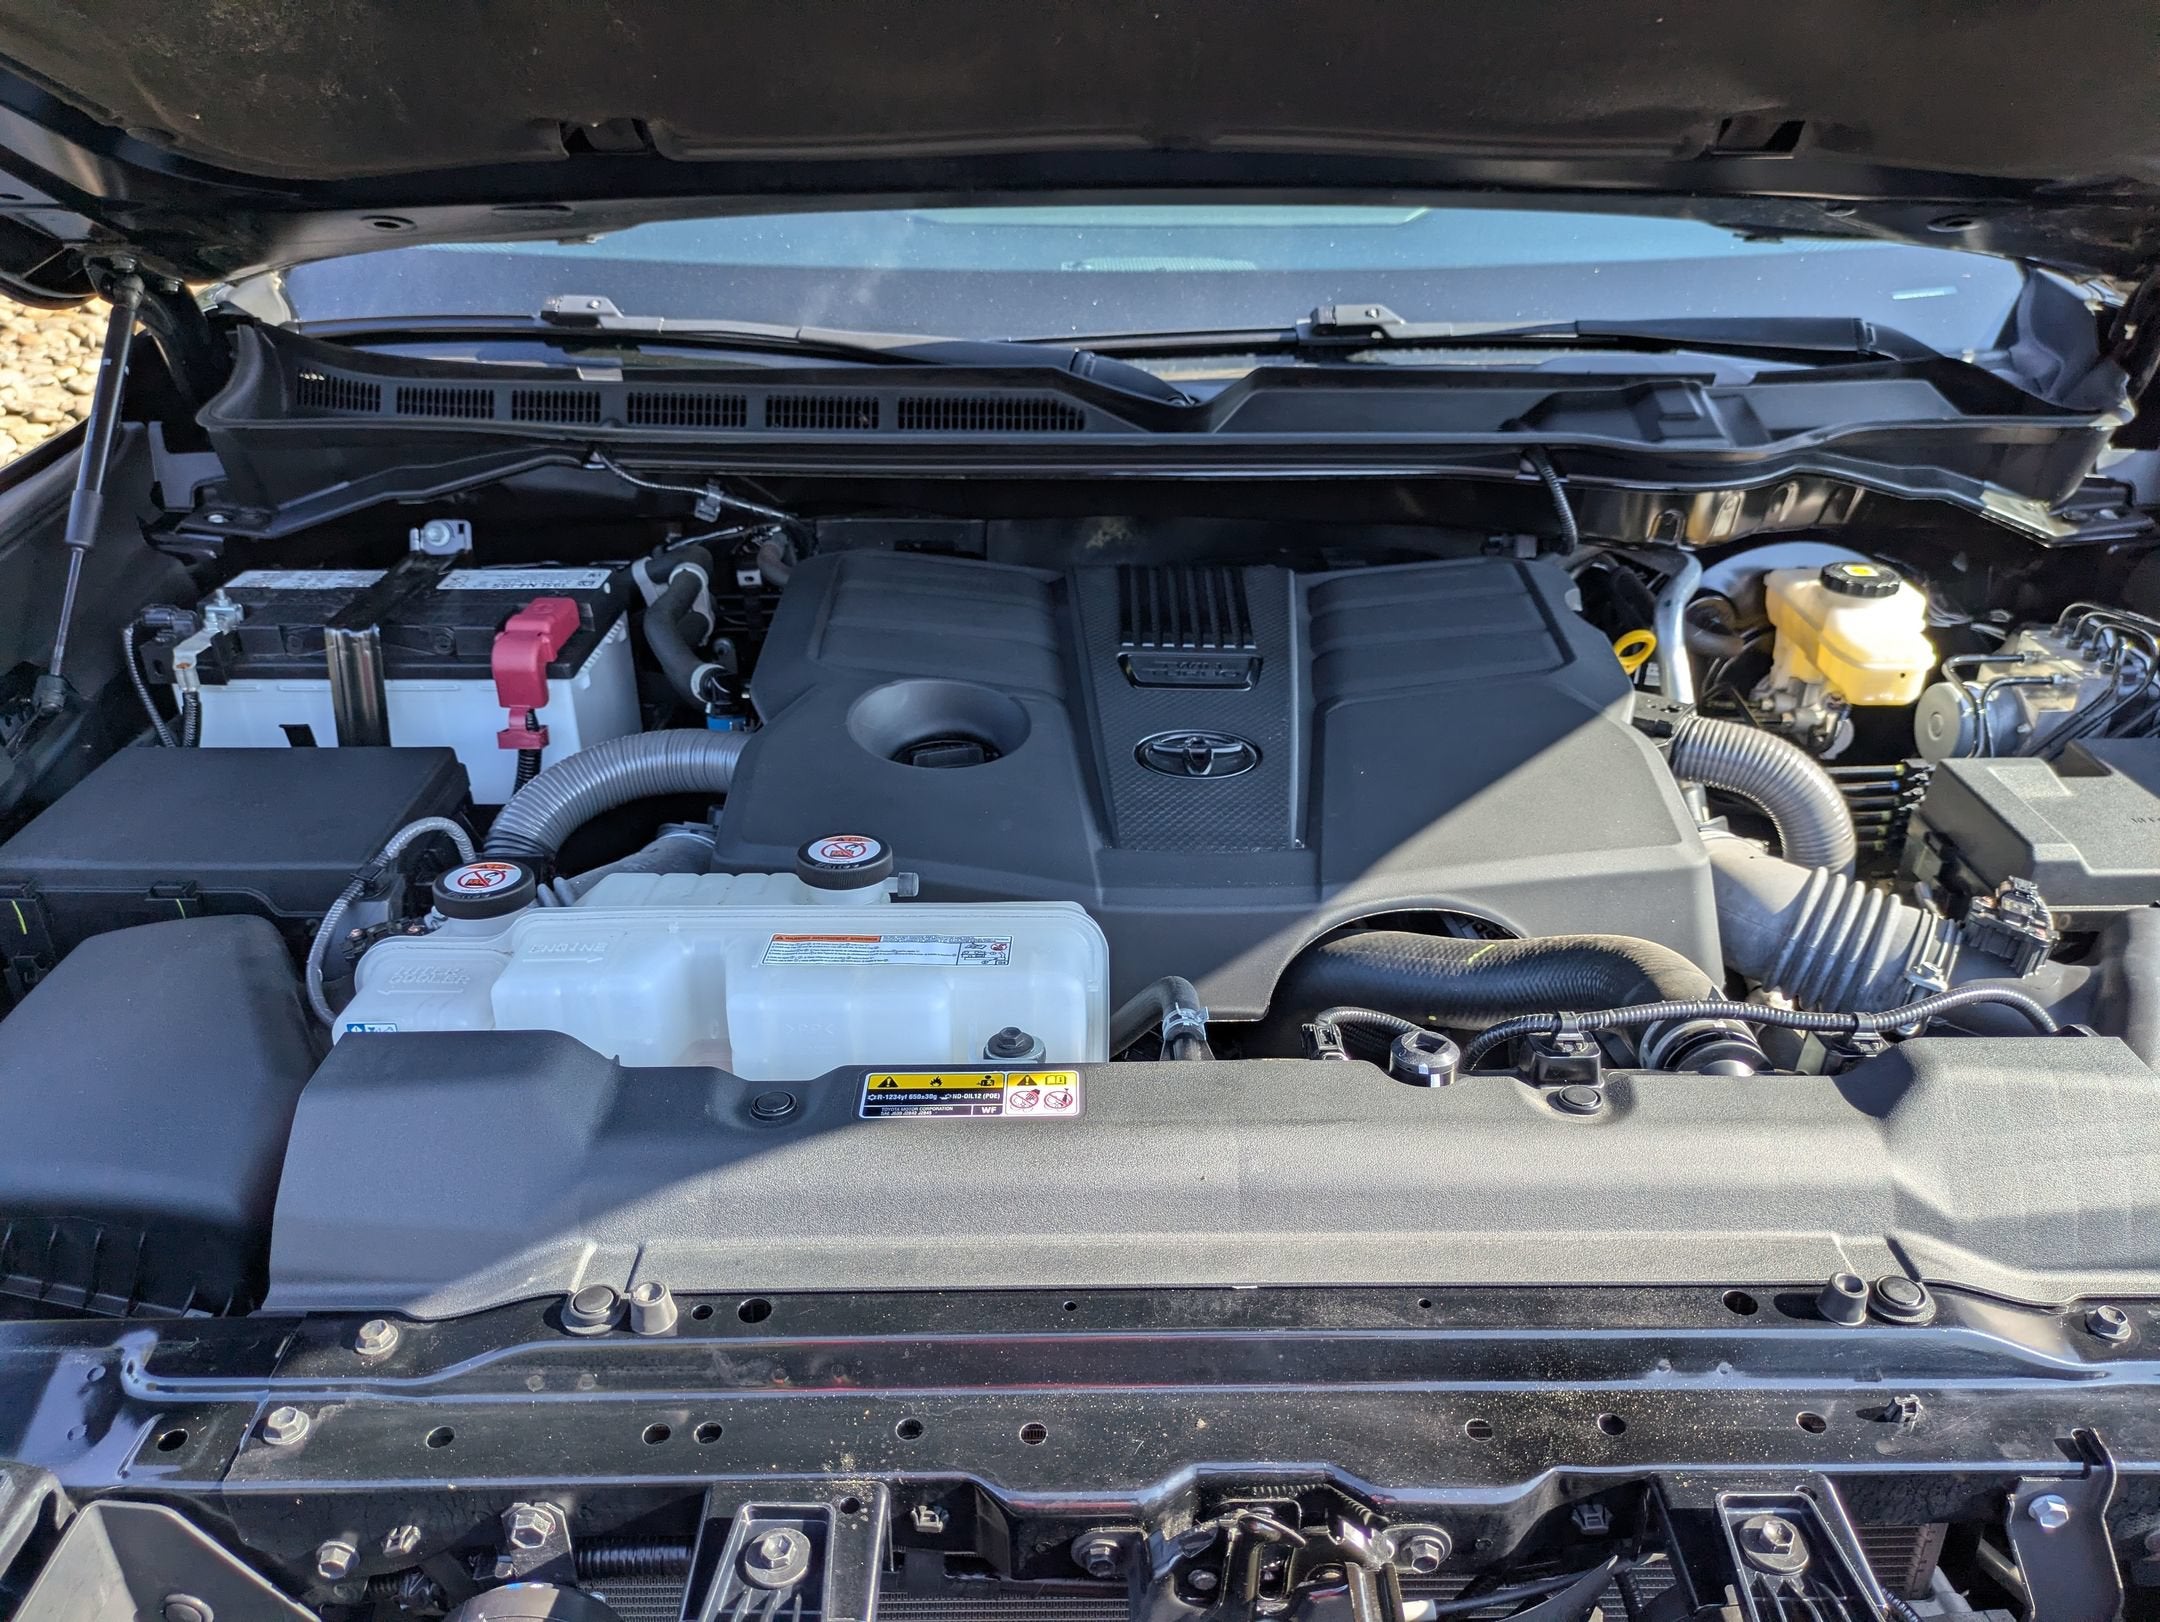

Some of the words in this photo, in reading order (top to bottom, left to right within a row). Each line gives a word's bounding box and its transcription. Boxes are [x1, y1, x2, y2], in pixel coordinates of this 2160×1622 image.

[527, 941, 609, 954] ENGINE
[388, 974, 471, 985] COOLER
[877, 1093, 907, 1101] R-1234yf
[952, 1092, 982, 1100] ND-OIL12
[983, 1092, 1001, 1100] (POE)
[981, 1106, 997, 1114] WF
